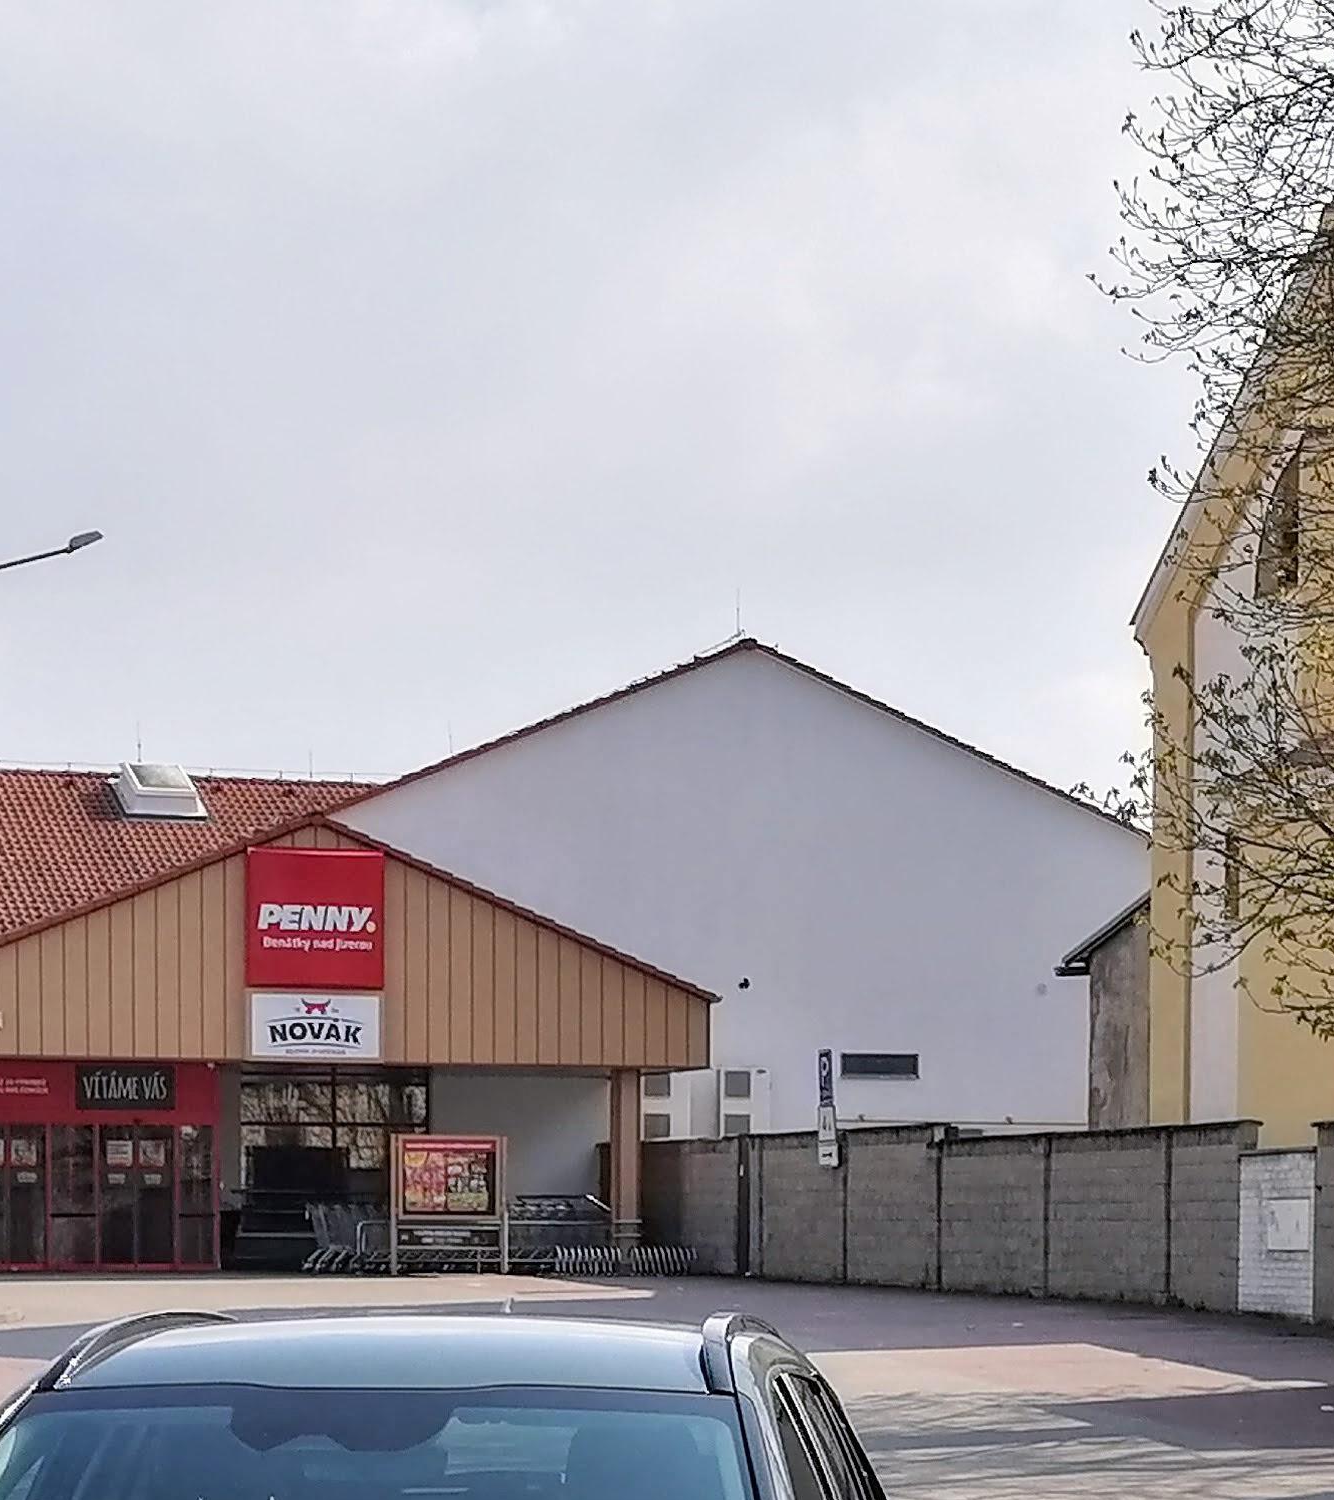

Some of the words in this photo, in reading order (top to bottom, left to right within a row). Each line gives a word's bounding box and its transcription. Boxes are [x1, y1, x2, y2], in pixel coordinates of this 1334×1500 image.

[268, 1017, 363, 1045] NOVÁK
[83, 1070, 139, 1100] VÍTÁME
[141, 1071, 167, 1100] VÁS
